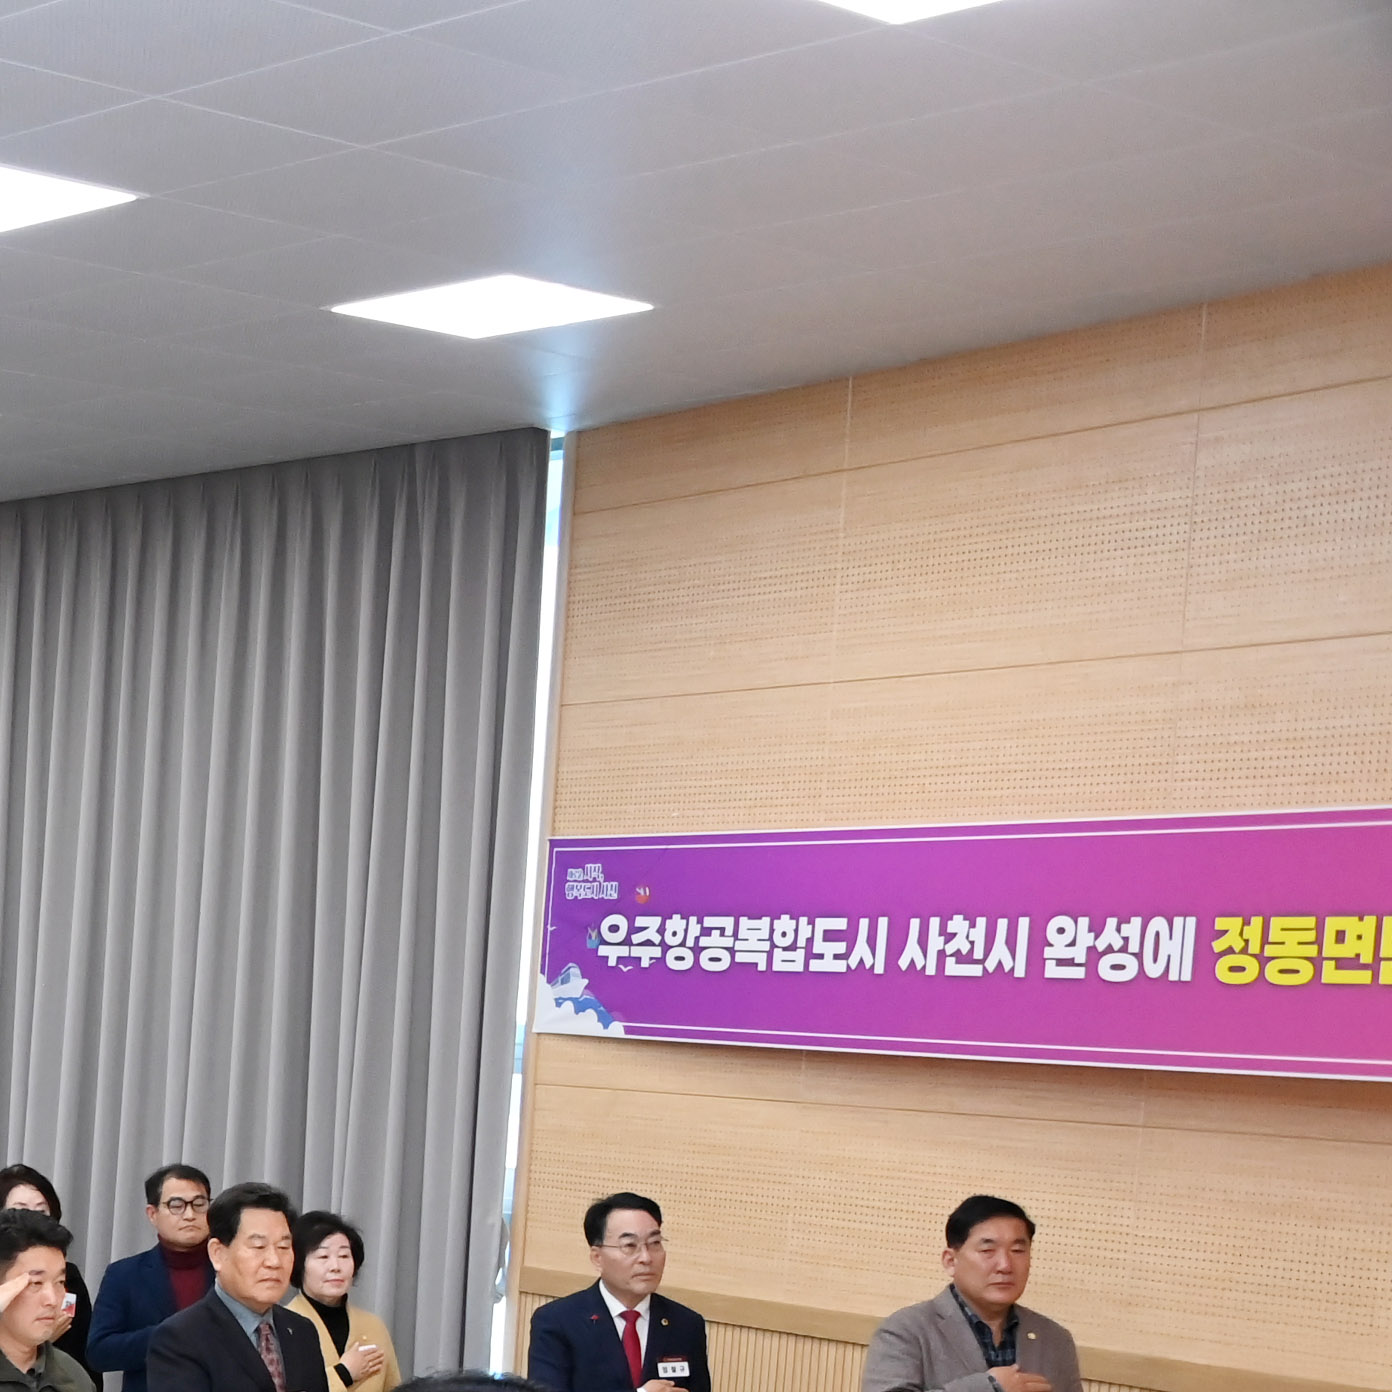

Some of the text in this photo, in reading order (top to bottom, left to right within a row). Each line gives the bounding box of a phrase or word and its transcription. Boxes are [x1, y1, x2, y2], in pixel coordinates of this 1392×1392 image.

[597, 914, 1392, 986] 우주항공복합도시 사천시 완성에 정동면
